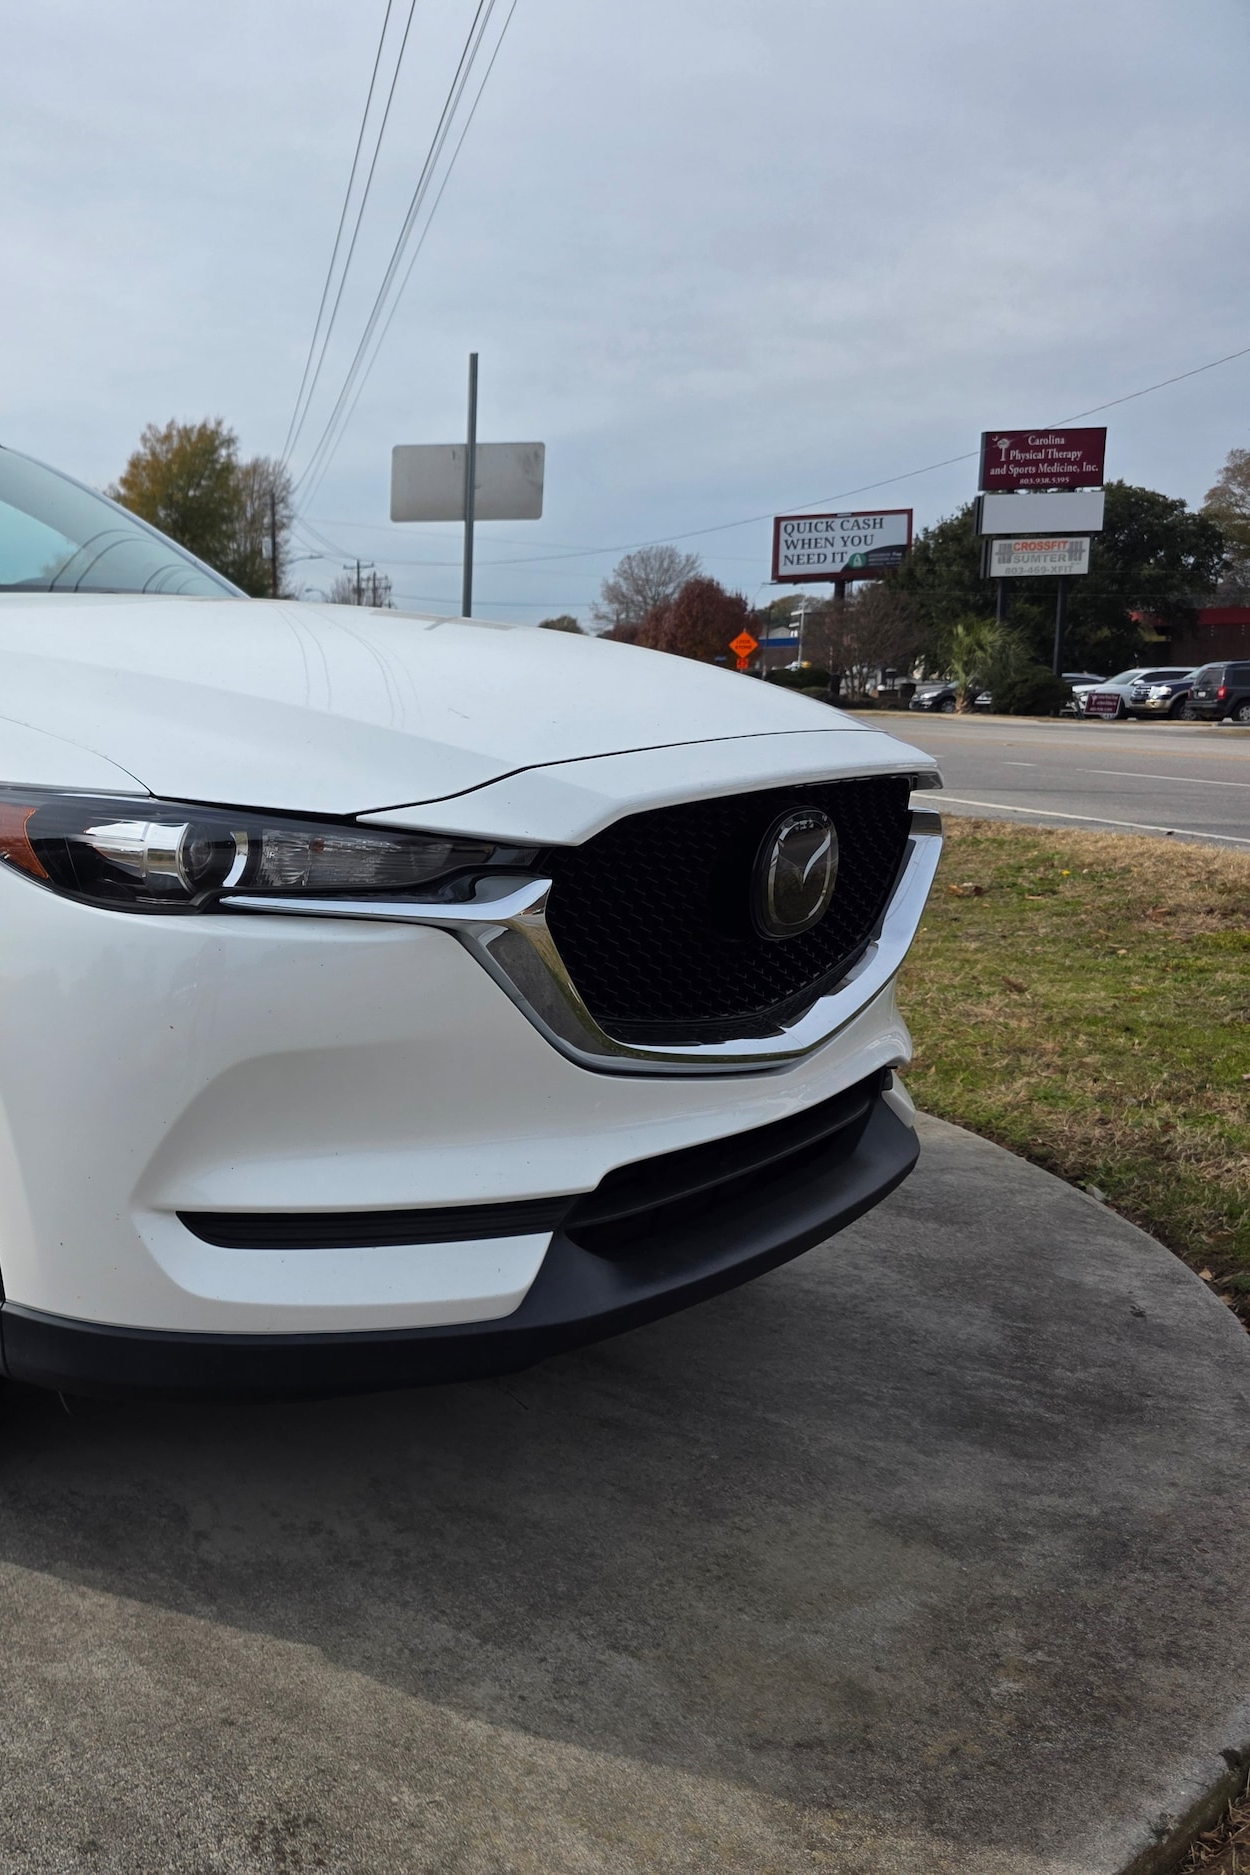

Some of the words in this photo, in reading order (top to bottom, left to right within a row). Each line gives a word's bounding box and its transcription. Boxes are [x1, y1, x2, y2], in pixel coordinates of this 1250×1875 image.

[1028, 434, 1065, 445] Carolina
[1010, 449, 1045, 462] Physical
[1047, 448, 1082, 461] Therapy
[990, 465, 1007, 475] and
[1008, 464, 1036, 477] Sports
[1038, 462, 1080, 473] Medicine,
[1082, 462, 1098, 472] Inc.
[783, 520, 835, 537] QUICK
[840, 517, 884, 531] CASH
[784, 537, 835, 550] WHEN
[840, 534, 874, 548] YOU
[1013, 541, 1068, 551] CROSSFIT
[783, 553, 827, 566] NEED
[830, 551, 848, 563] IT
[1013, 553, 1066, 564] SUMTER
[1005, 566, 1074, 575] 803-469-XFIT
